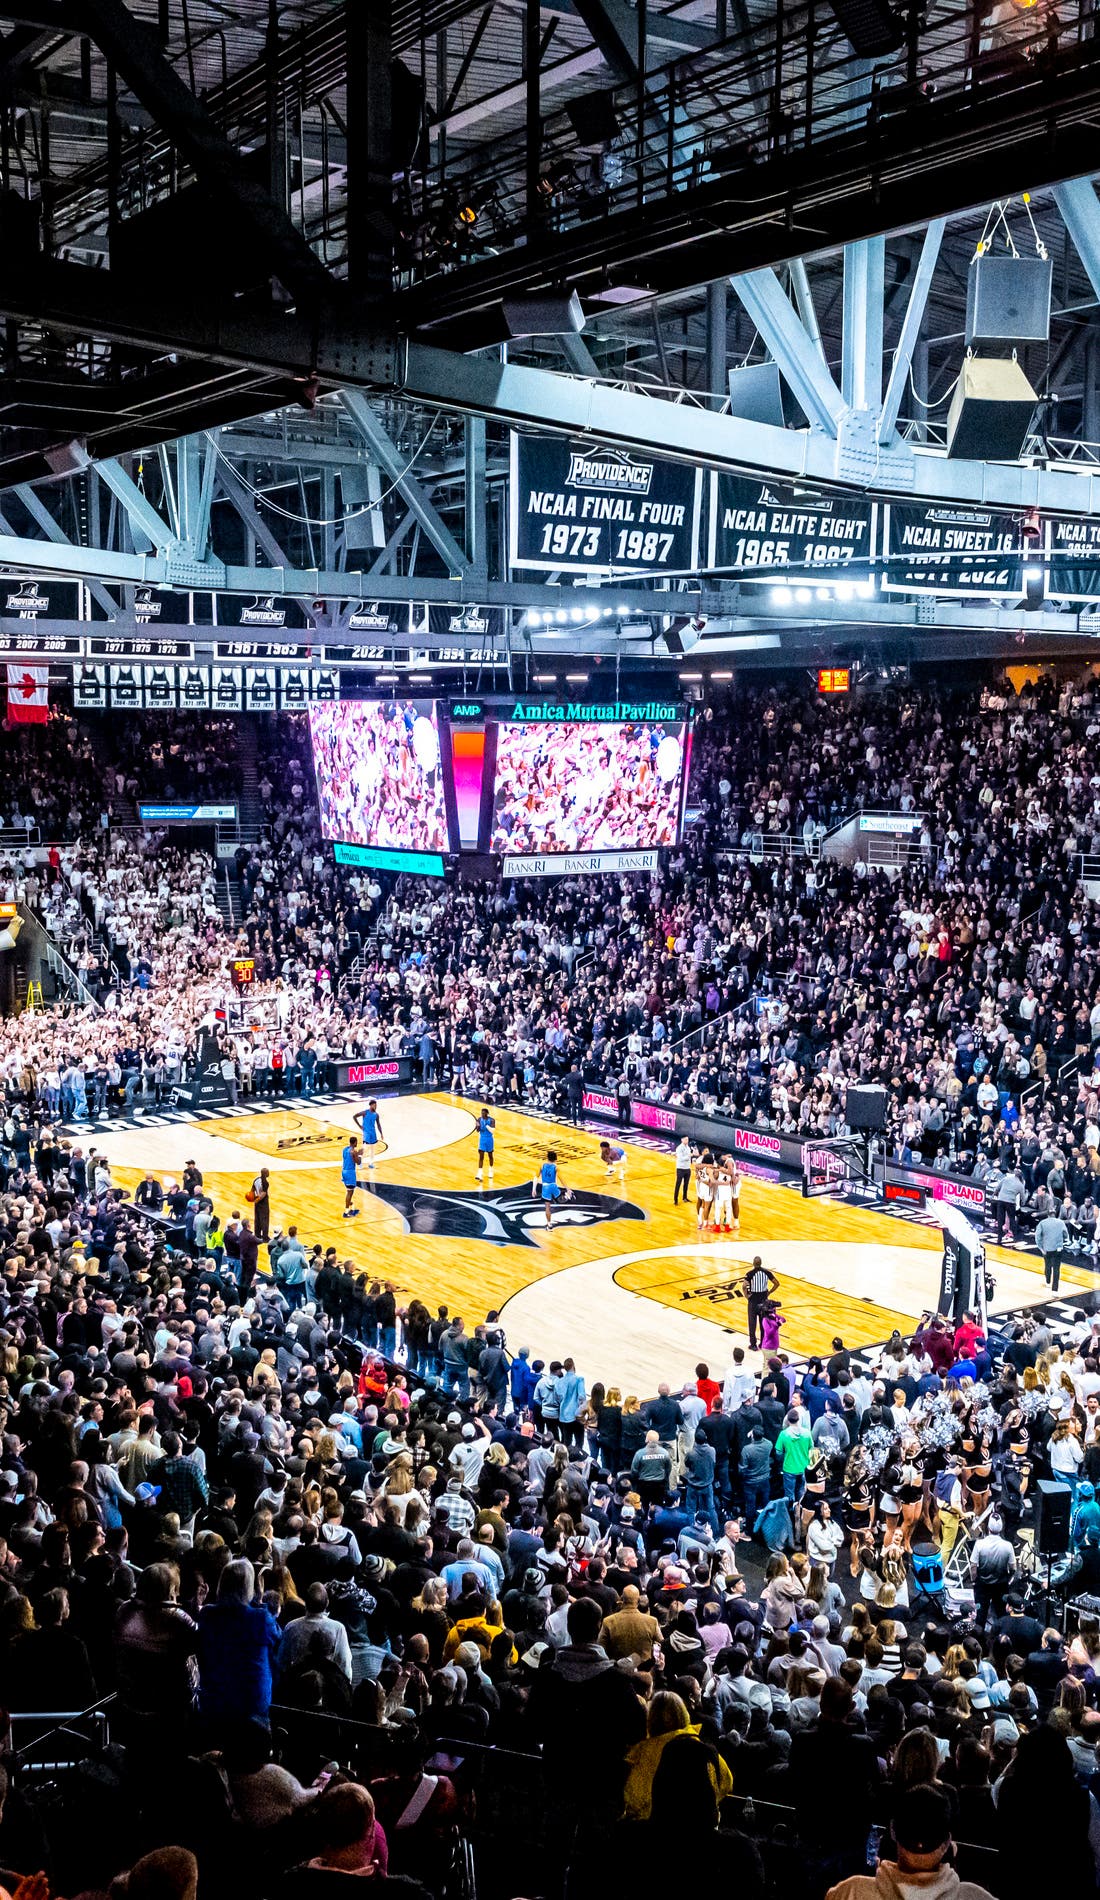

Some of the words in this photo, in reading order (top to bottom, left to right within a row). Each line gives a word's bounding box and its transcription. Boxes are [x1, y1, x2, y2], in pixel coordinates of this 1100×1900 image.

[571, 457, 650, 483] PROVIDENCE
[527, 491, 577, 518] NCAA
[581, 497, 635, 522] FINAL
[639, 503, 686, 526] FOUR
[723, 508, 767, 532] NCAA
[770, 513, 818, 535] ELITE
[819, 518, 867, 539] EIGHT
[1056, 523, 1087, 541] NCAA
[541, 523, 601, 556] 1973
[616, 529, 675, 562] 1987
[902, 526, 941, 547] NCAA
[944, 530, 993, 550] SWEET
[996, 534, 1013, 551] 16
[734, 538, 790, 566] 1965
[243, 611, 284, 622] PROVIDENCE
[16, 641, 38, 649] 2007
[44, 641, 66, 650] 2009
[105, 643, 124, 652] 1971
[132, 644, 151, 653] 1975
[352, 646, 384, 658] 2022
[455, 706, 480, 716] AMP
[512, 703, 565, 720] Amica
[567, 701, 620, 720] Mutual
[621, 702, 676, 720] Pavilion
[238, 969, 251, 981] 30
[349, 1062, 399, 1083] MIDLAND
[61, 1091, 372, 1136] PROVIDENCE
[735, 1129, 781, 1151] MIDLAND
[943, 1182, 985, 1204] IDLAND
[945, 1245, 958, 1294] Amica
